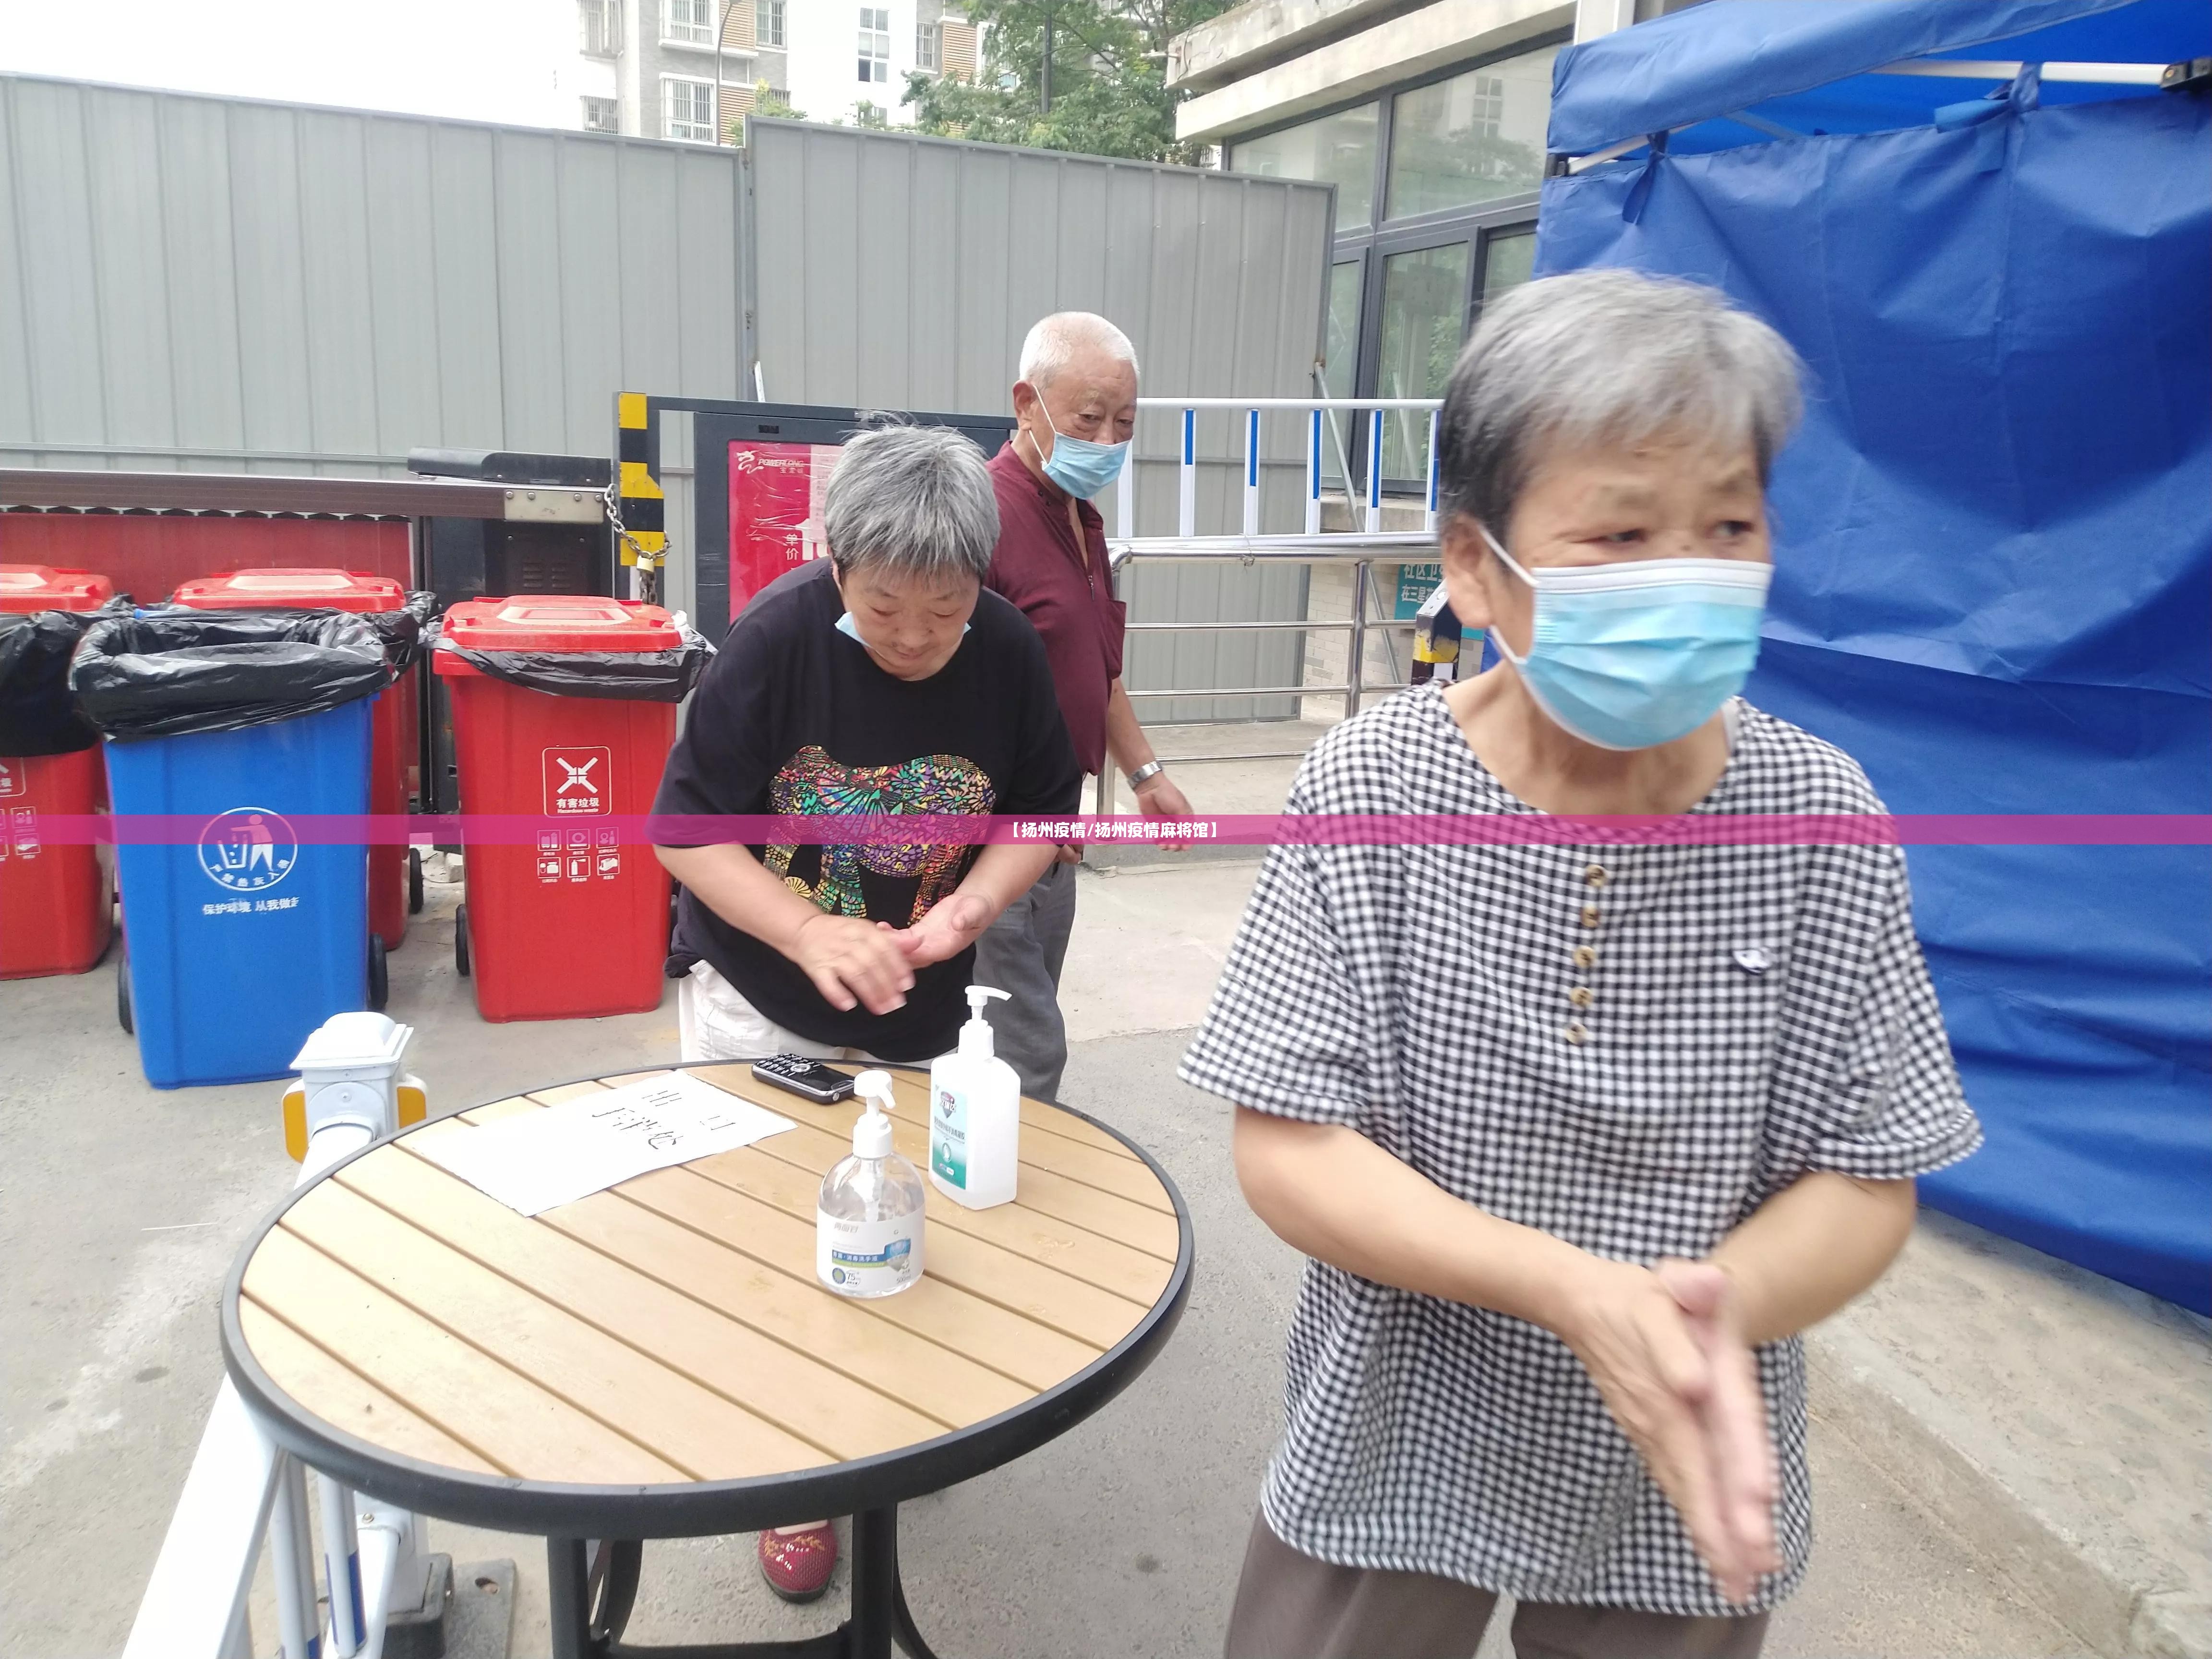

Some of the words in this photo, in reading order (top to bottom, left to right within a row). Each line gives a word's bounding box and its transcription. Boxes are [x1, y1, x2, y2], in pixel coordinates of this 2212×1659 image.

[785, 533, 799, 561] 单价
[556, 797, 600, 808] 有害垃圾
[203, 902, 252, 915] 保护环境
